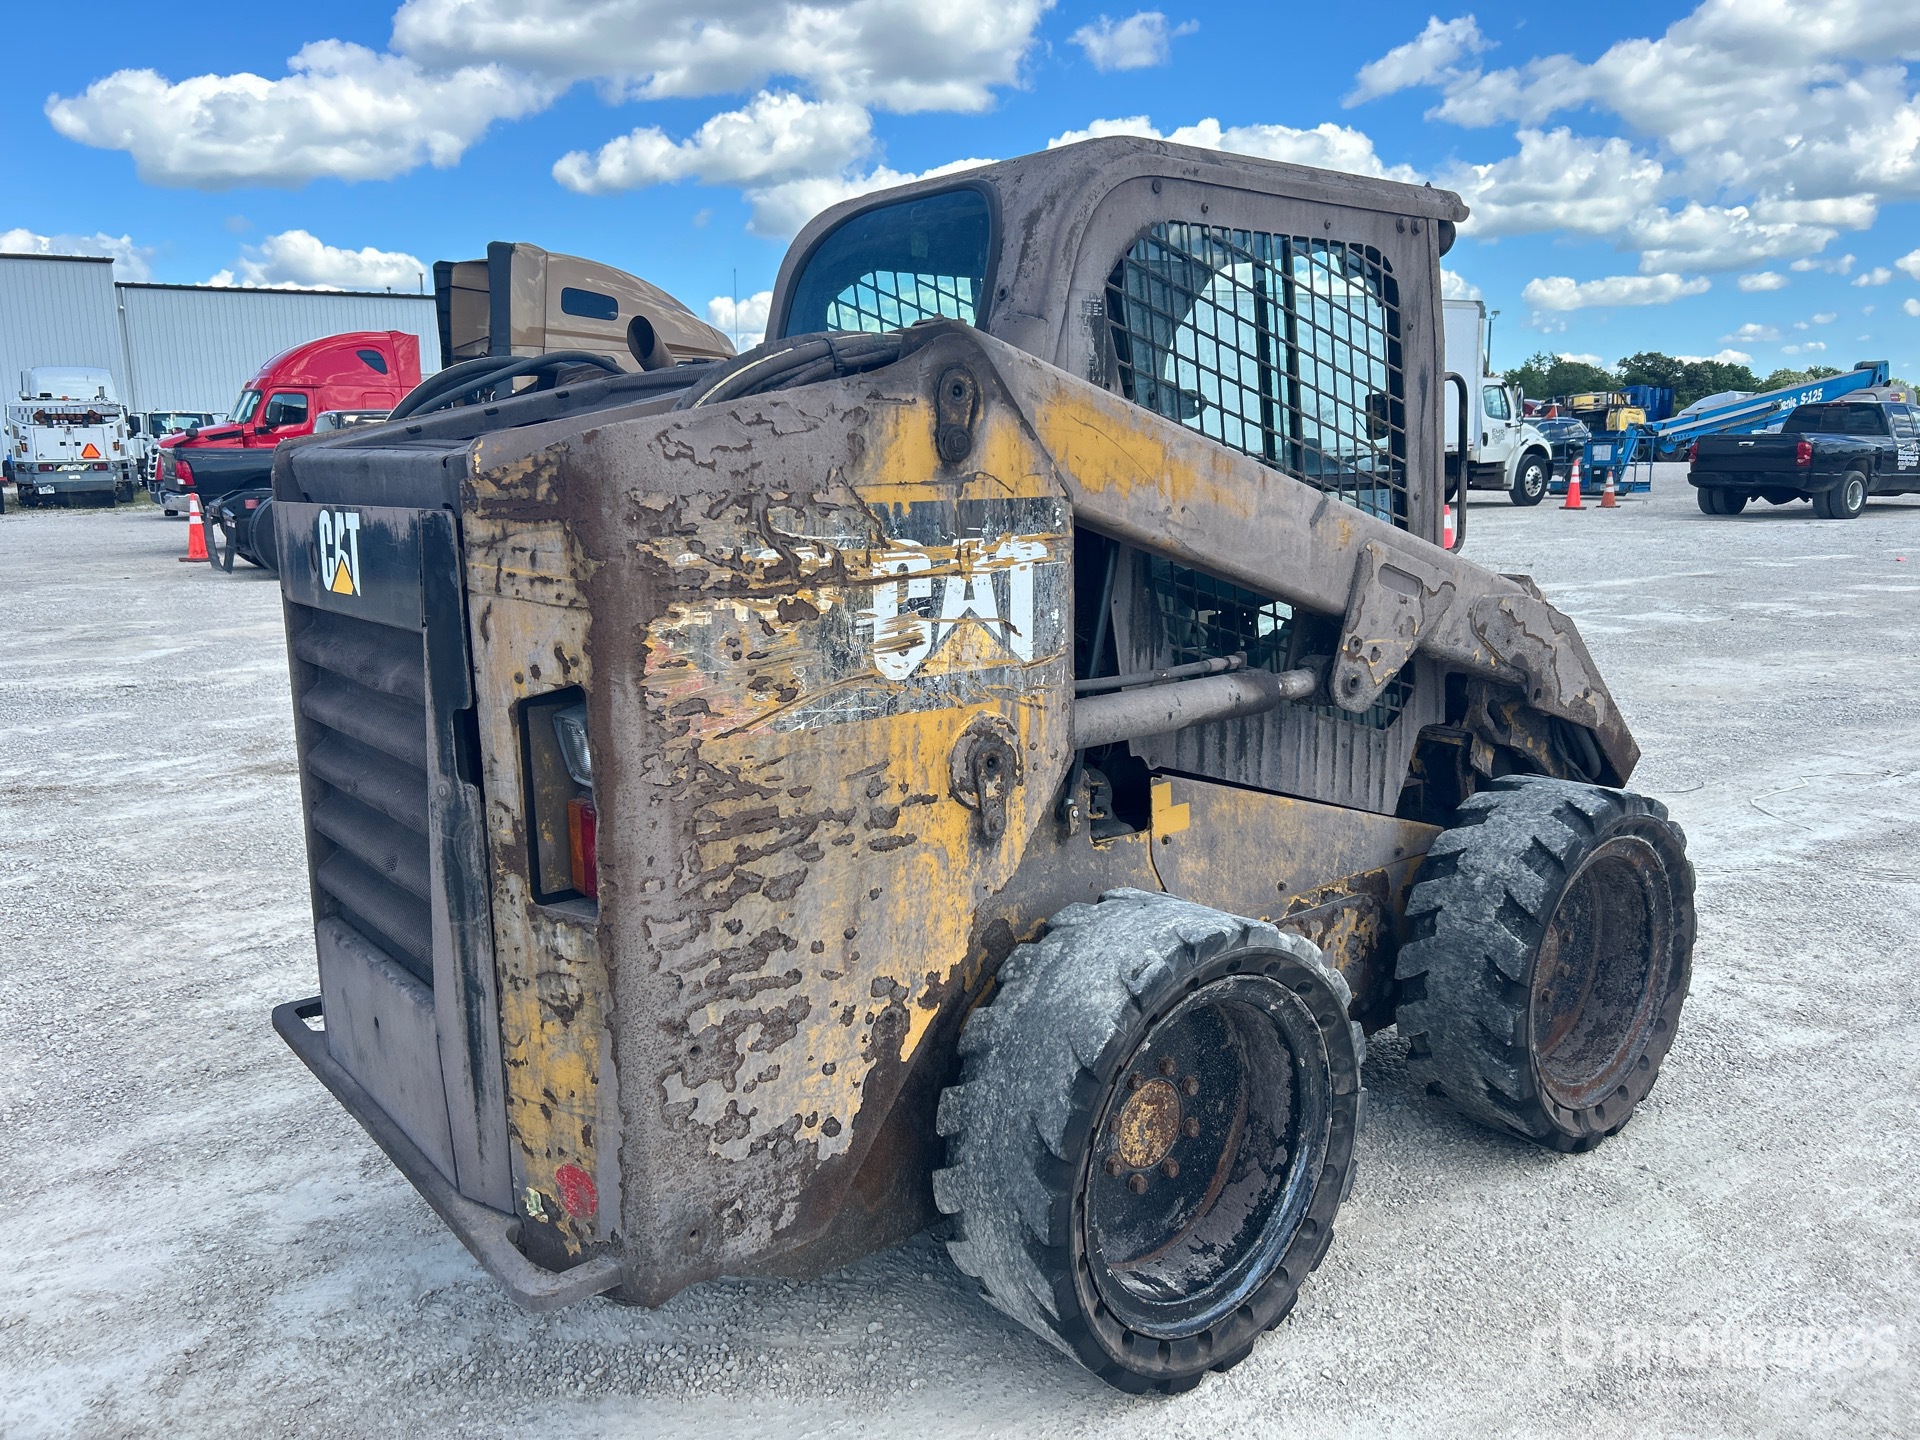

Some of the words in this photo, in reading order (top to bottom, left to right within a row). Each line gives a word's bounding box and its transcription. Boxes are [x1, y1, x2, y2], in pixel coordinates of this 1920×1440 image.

[1800, 388, 1823, 404] S-125
[318, 509, 362, 597] CAT
[873, 533, 1048, 681] CAT
